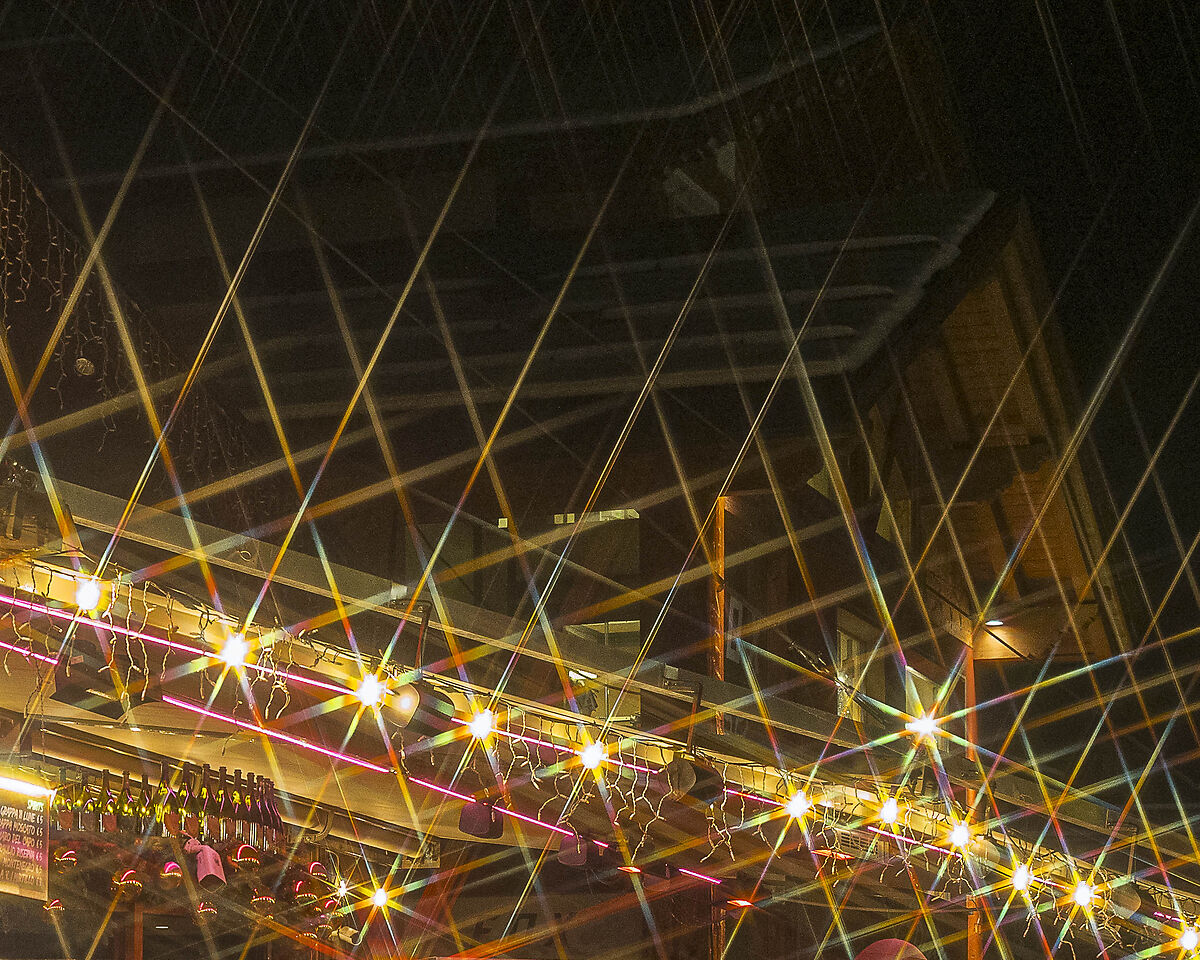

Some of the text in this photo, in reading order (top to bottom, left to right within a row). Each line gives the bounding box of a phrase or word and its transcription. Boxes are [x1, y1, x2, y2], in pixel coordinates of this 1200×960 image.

[27, 799, 44, 812] SPIRITS
[0, 806, 19, 820] GRAPPA
[37, 814, 44, 825] €5
[13, 821, 36, 836] MOSCATO
[36, 827, 43, 837] €5
[12, 833, 22, 845] DEL
[22, 836, 35, 849] CAPO
[36, 839, 43, 849] €5
